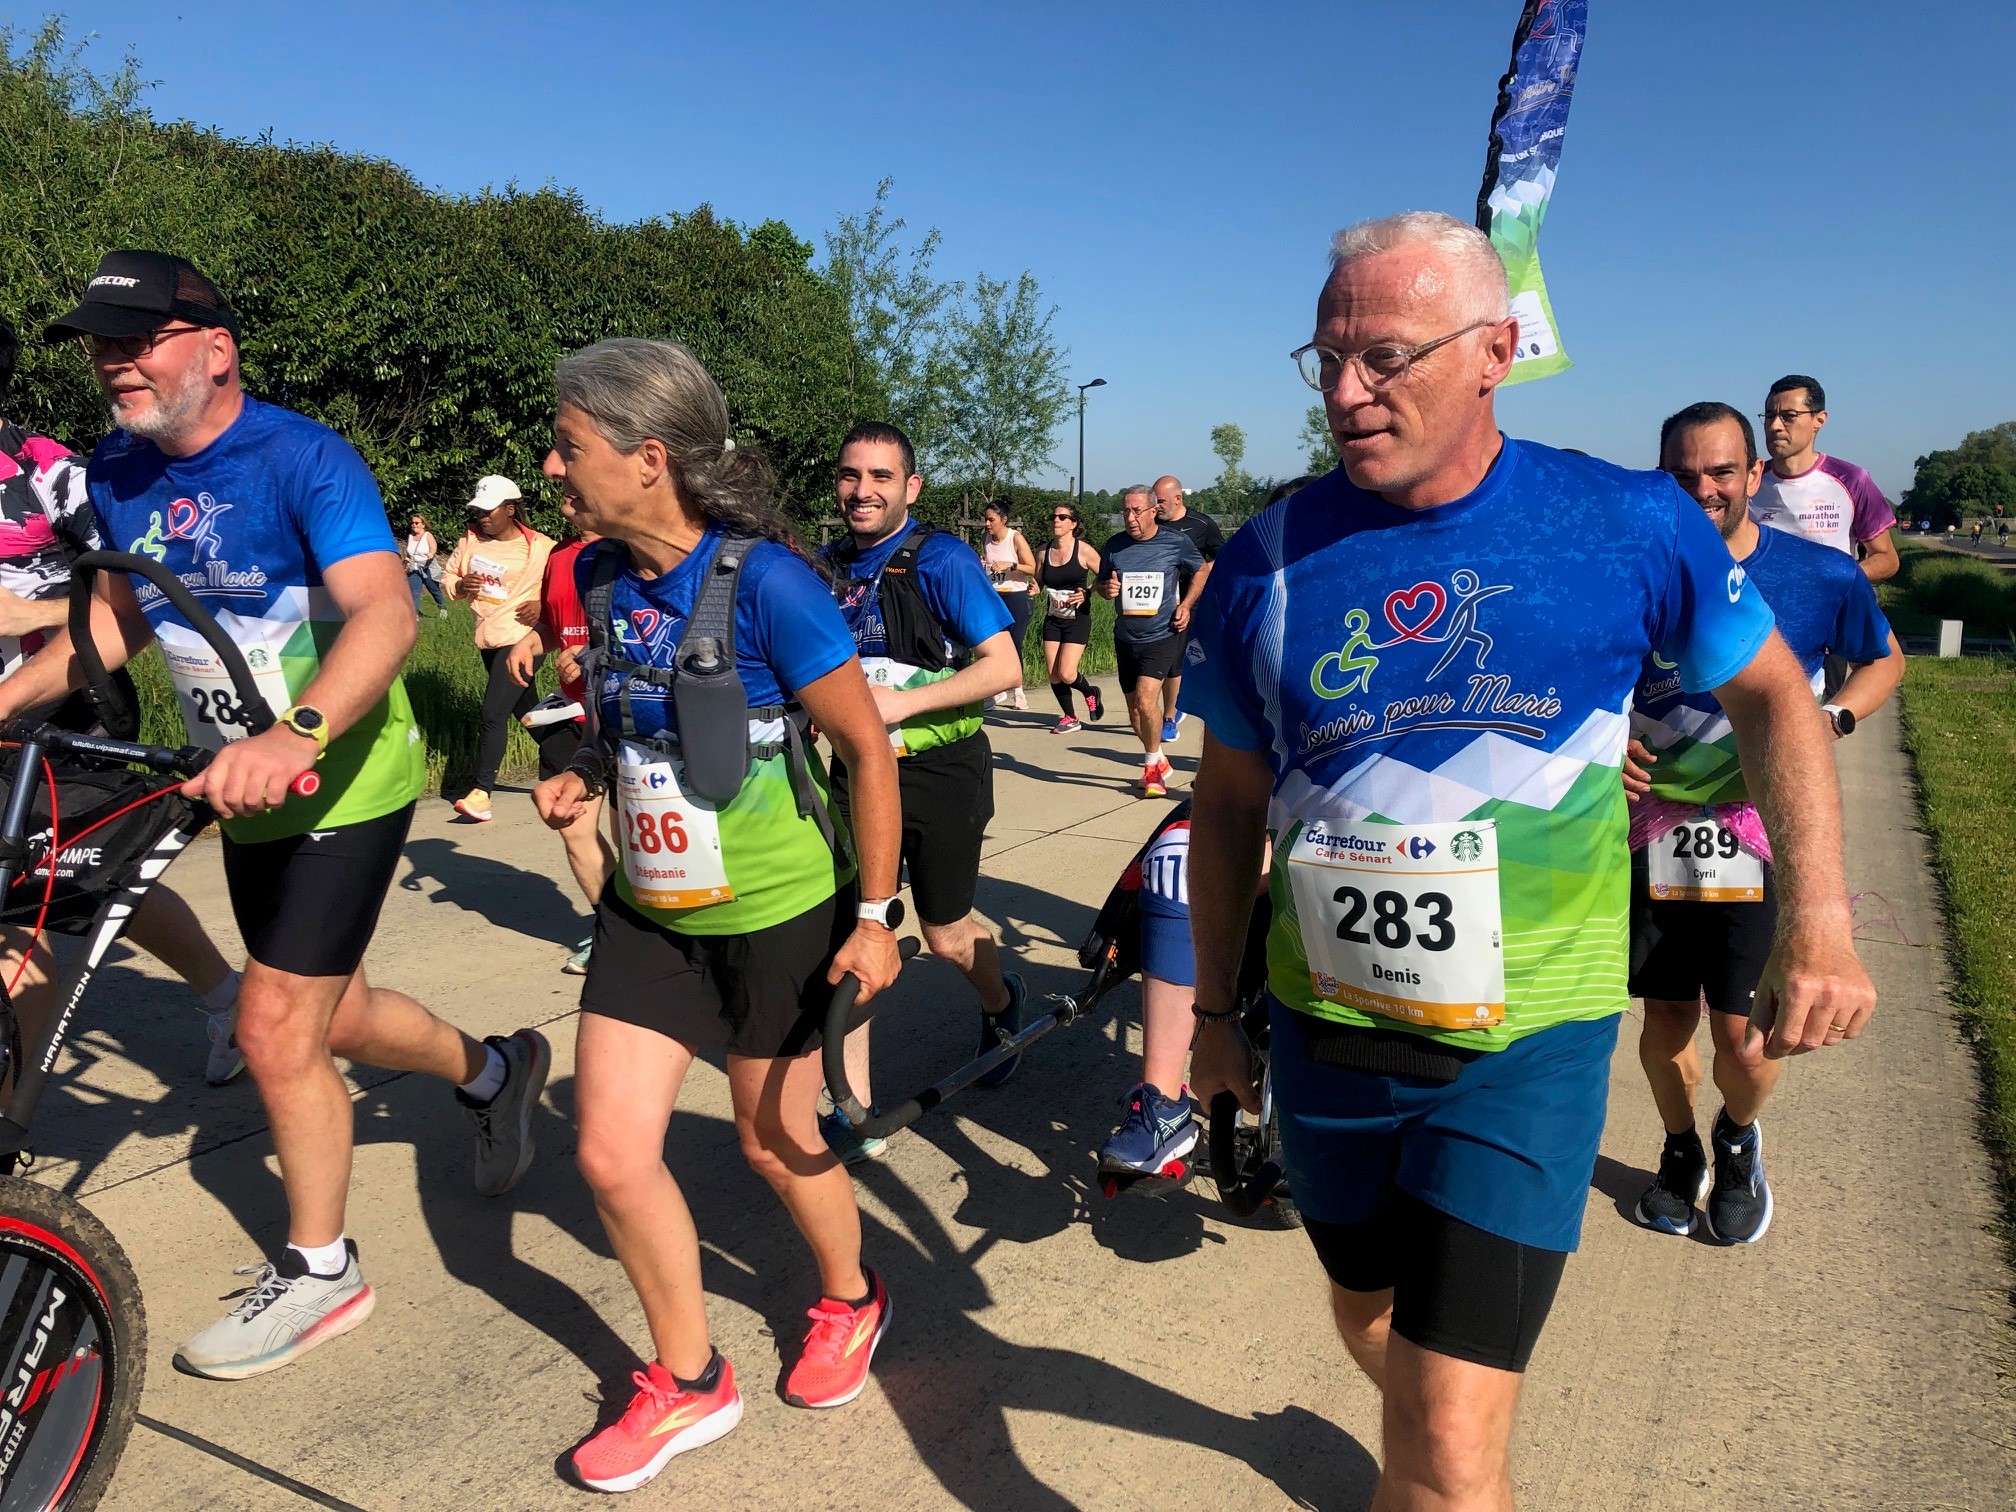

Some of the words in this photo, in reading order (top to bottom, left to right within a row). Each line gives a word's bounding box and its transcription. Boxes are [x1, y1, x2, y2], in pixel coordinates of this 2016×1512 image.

[87, 275, 134, 291] PRECOR
[1799, 512, 1840, 520] marathon
[1815, 503, 1835, 511] semi
[1827, 520, 1839, 528] km
[206, 560, 267, 587] Marie
[1127, 585, 1159, 598] 1297
[166, 649, 210, 666] Carrefour
[191, 687, 243, 725] 28
[1297, 702, 1375, 755] Courir
[1384, 693, 1455, 735] pour
[1468, 673, 1562, 718] Marie
[1306, 829, 1386, 852] Carrefour
[1672, 826, 1739, 859] 289
[1315, 847, 1345, 860] Carré
[1349, 852, 1392, 864] Sénart
[635, 864, 686, 880] Stéphanie
[1693, 868, 1716, 881] Cyril
[1333, 885, 1456, 952] 283
[1372, 963, 1422, 985] Denis
[1343, 989, 1352, 999] La
[1354, 993, 1391, 1011] Sportive
[1394, 1003, 1406, 1014] 10
[1407, 1005, 1425, 1018] km
[40, 971, 91, 1073] MARATHON
[0, 1420, 27, 1493] HIPP
